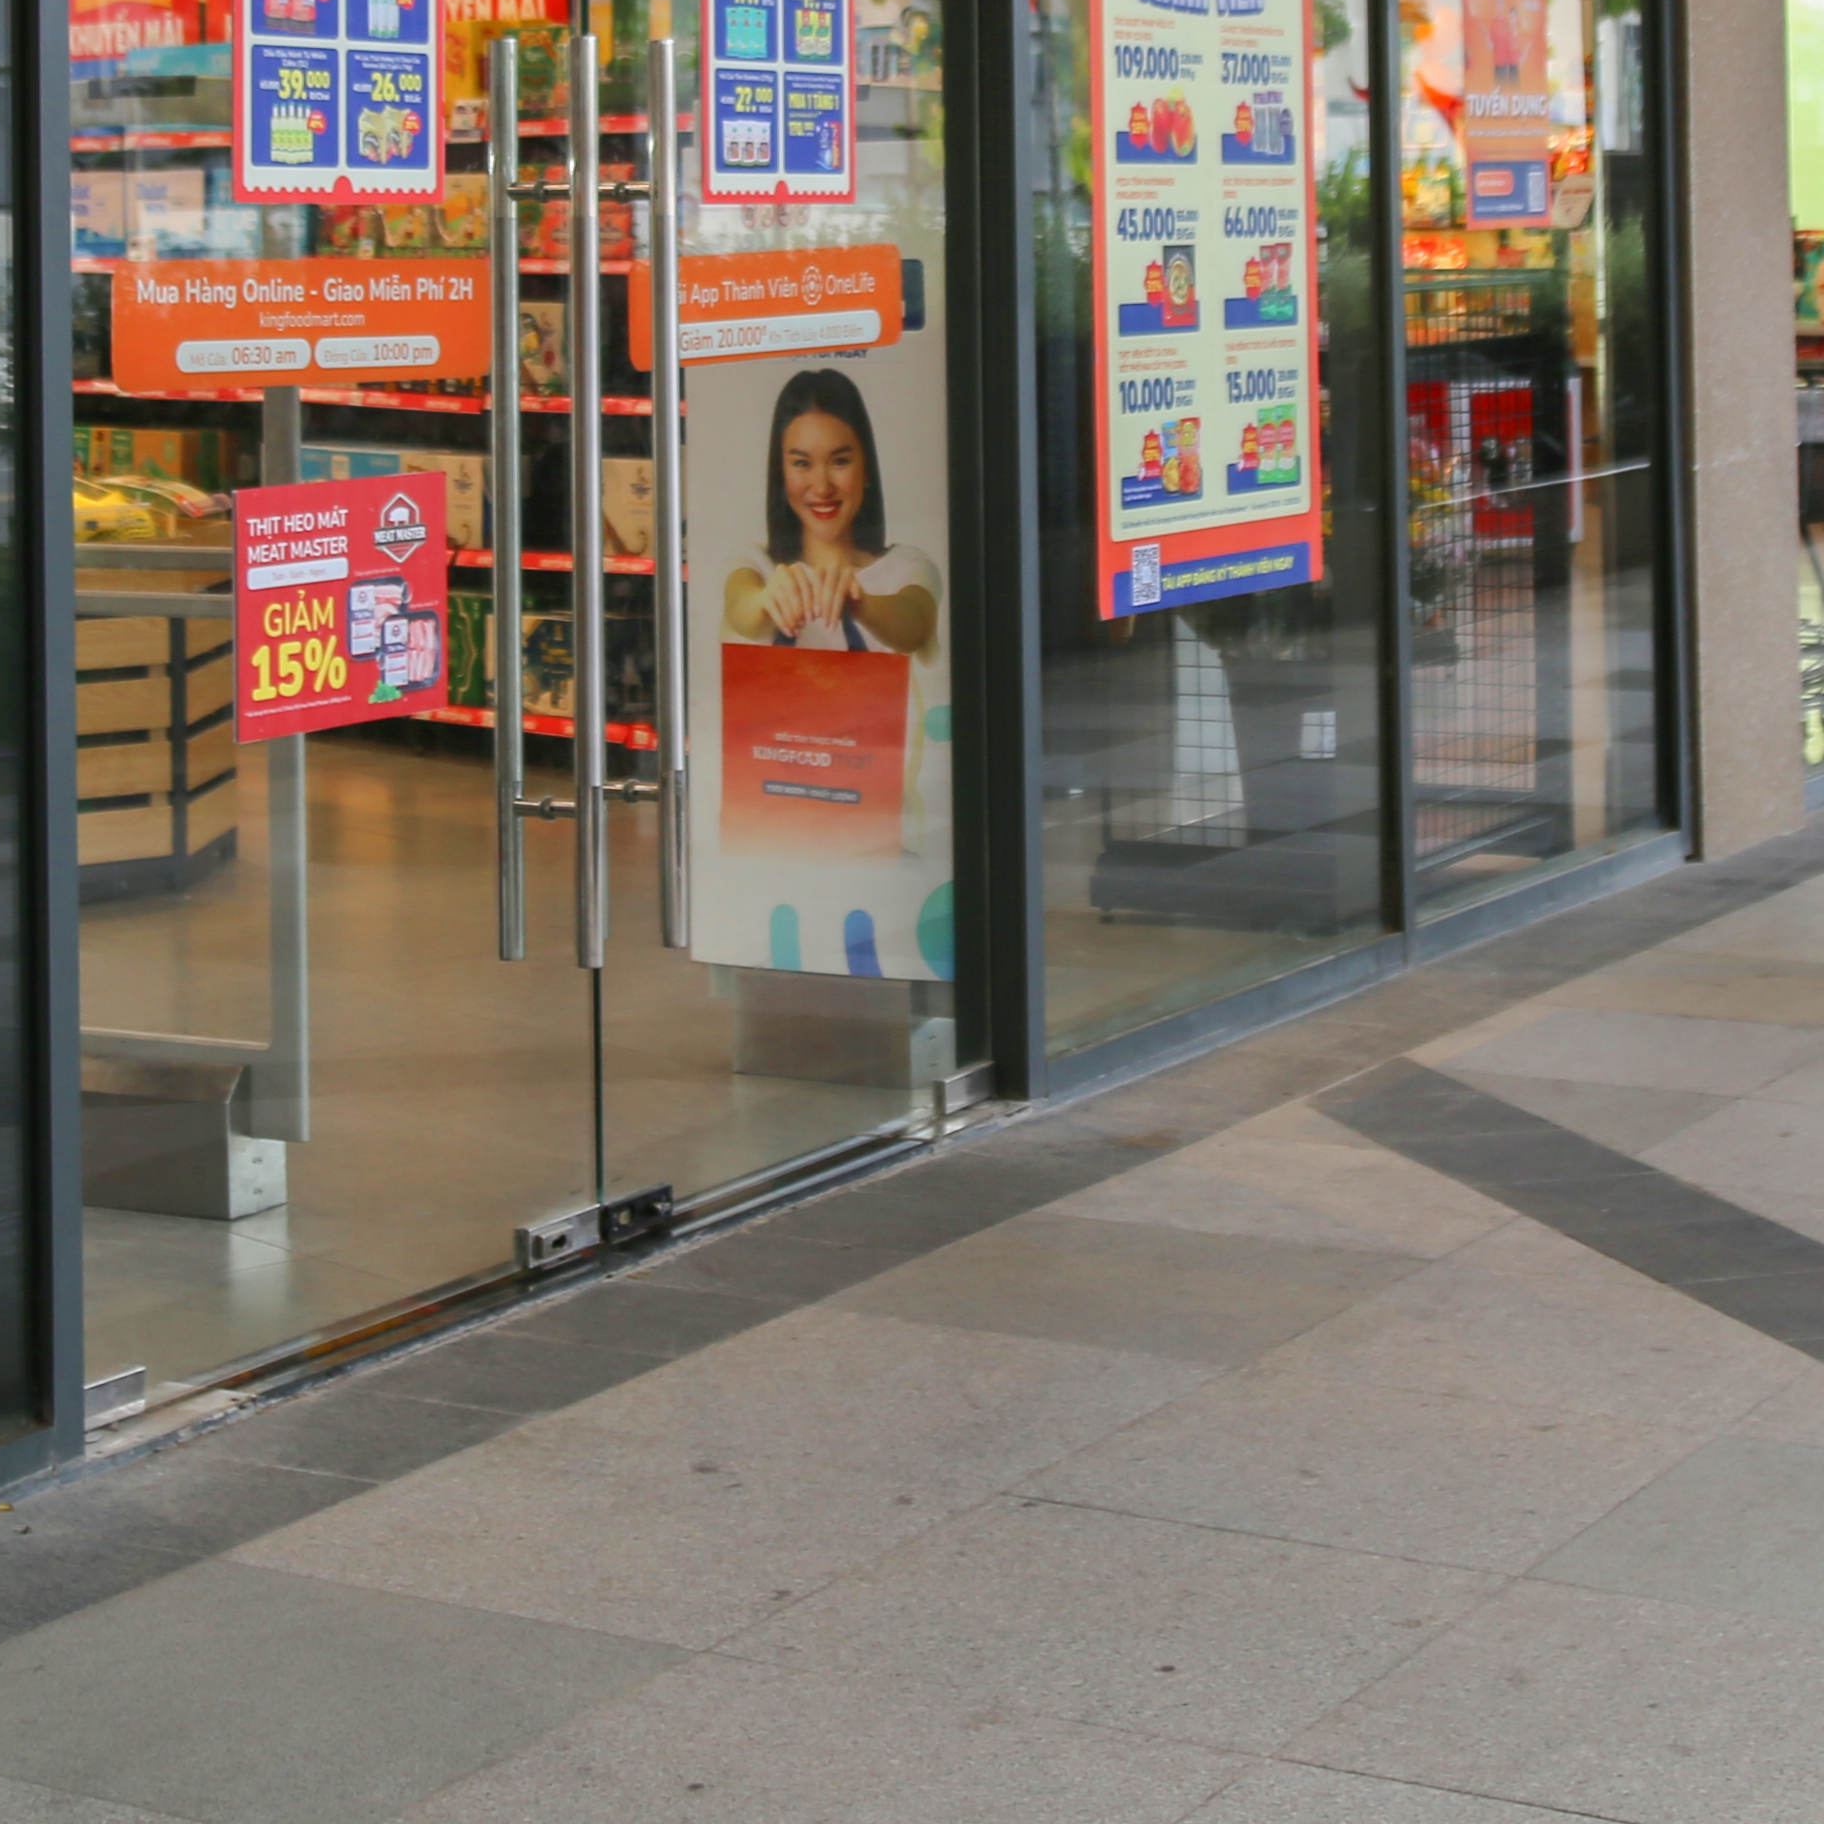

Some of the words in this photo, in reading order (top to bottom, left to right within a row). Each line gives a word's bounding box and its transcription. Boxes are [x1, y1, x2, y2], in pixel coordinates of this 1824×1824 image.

[1115, 45, 1179, 80] 109.000
[1117, 207, 1175, 242] 45.000
[137, 278, 179, 304] Mua
[185, 277, 237, 308] Hàng
[242, 276, 305, 304] Online
[323, 278, 365, 303] Giao
[369, 275, 411, 303] Miễn
[415, 275, 445, 302] Phí
[448, 277, 473, 301] 2H
[690, 282, 720, 308] App
[721, 278, 765, 302] Thành
[768, 276, 799, 299] Viên
[825, 270, 876, 297] OneLife
[259, 311, 365, 331] kingfoodmart.com
[231, 346, 272, 366] 06:30
[275, 350, 297, 365] am
[372, 343, 410, 362] 10:00
[412, 344, 433, 364] pm
[679, 329, 714, 352] Giảm
[247, 516, 281, 539] THỊT
[284, 513, 314, 534] HEO
[317, 505, 349, 532] MÁT
[374, 529, 395, 545] MEAT
[395, 526, 426, 542] MASTER
[247, 542, 288, 564] MEAT
[290, 536, 348, 559] MASTER
[263, 589, 335, 638] GIẢM
[251, 635, 348, 702] 15%
